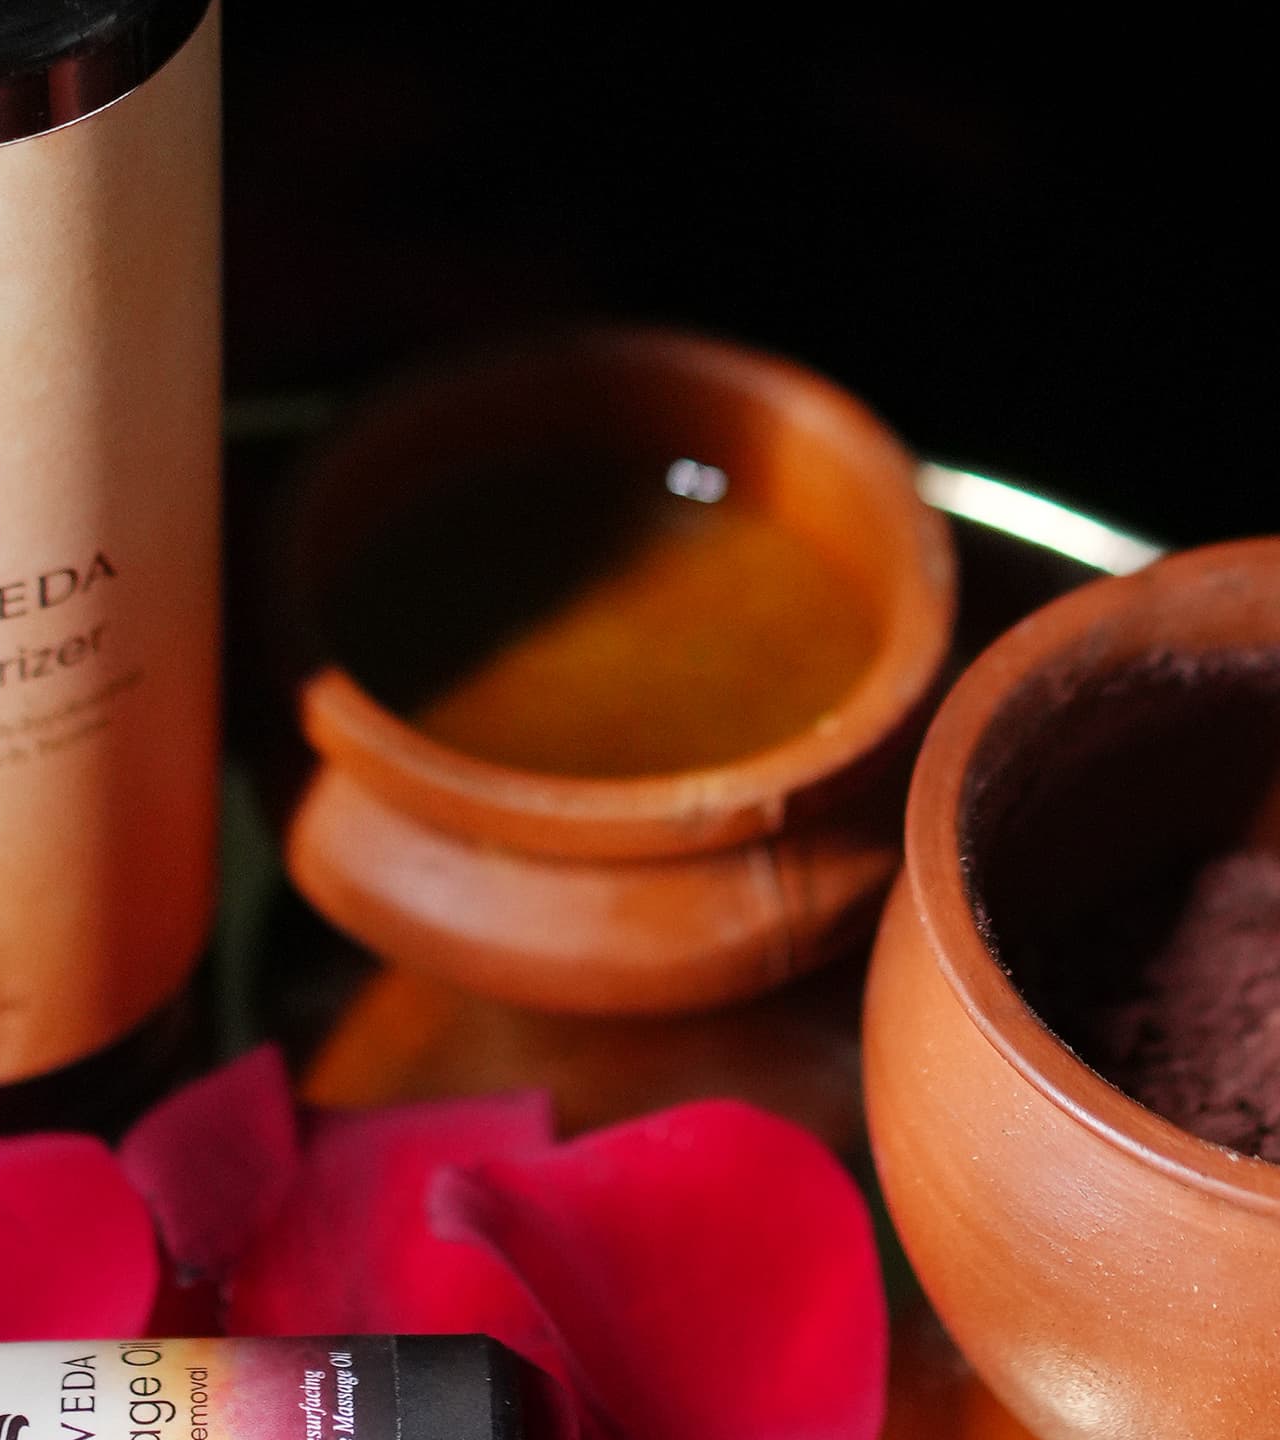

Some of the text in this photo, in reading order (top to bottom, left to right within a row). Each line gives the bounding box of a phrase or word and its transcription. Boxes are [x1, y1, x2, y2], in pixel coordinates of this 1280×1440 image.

[117, 1342, 163, 1367] Oil
[328, 1351, 353, 1368] Oil
[332, 1369, 360, 1436] Massage
